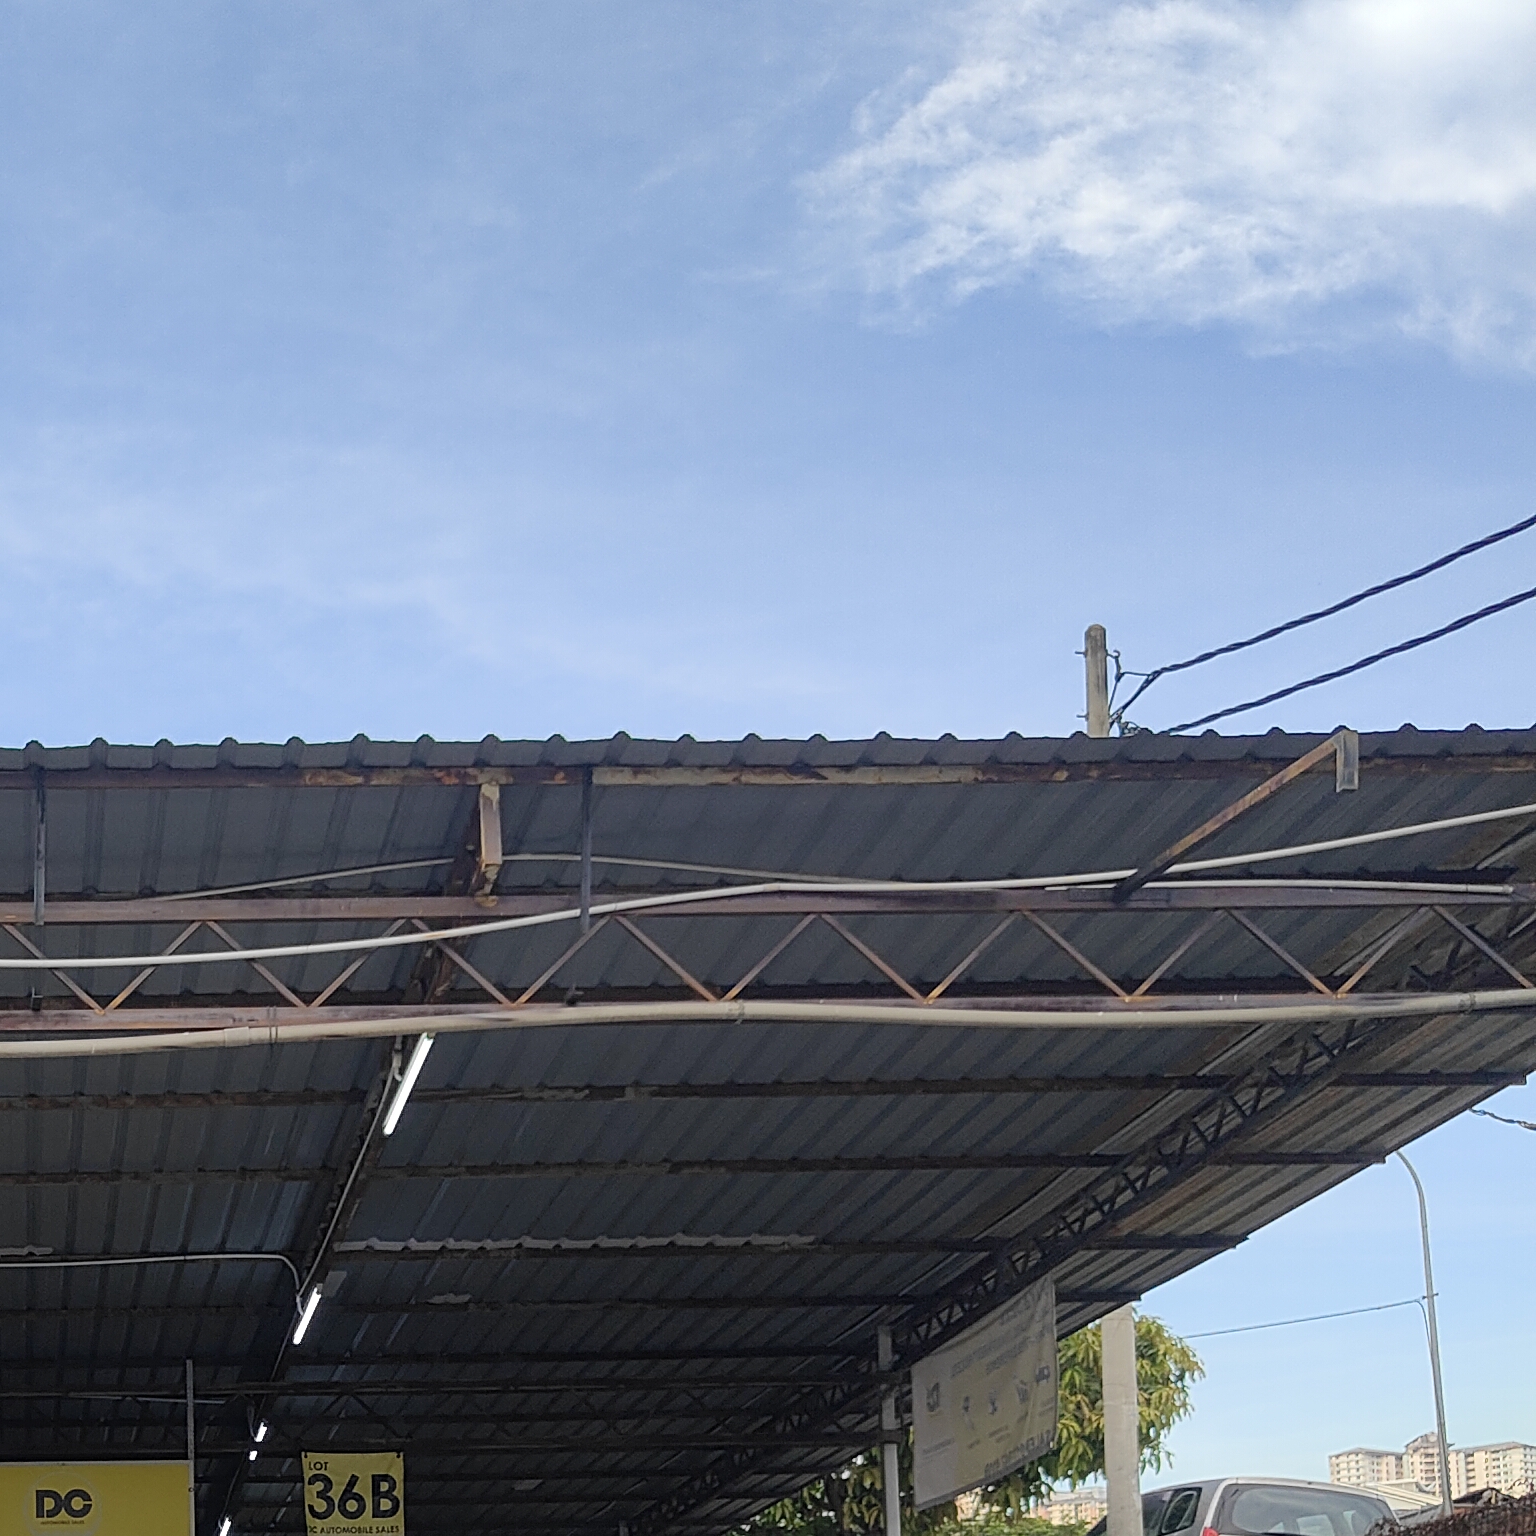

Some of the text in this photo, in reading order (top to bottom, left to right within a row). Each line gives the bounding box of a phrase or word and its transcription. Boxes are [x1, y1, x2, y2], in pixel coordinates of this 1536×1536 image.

[308, 1461, 329, 1471] LOT
[36, 1489, 93, 1519] DC
[307, 1473, 400, 1520] 36B
[319, 1526, 373, 1534] AUTOMOBILE
[375, 1525, 400, 1534] SALES
